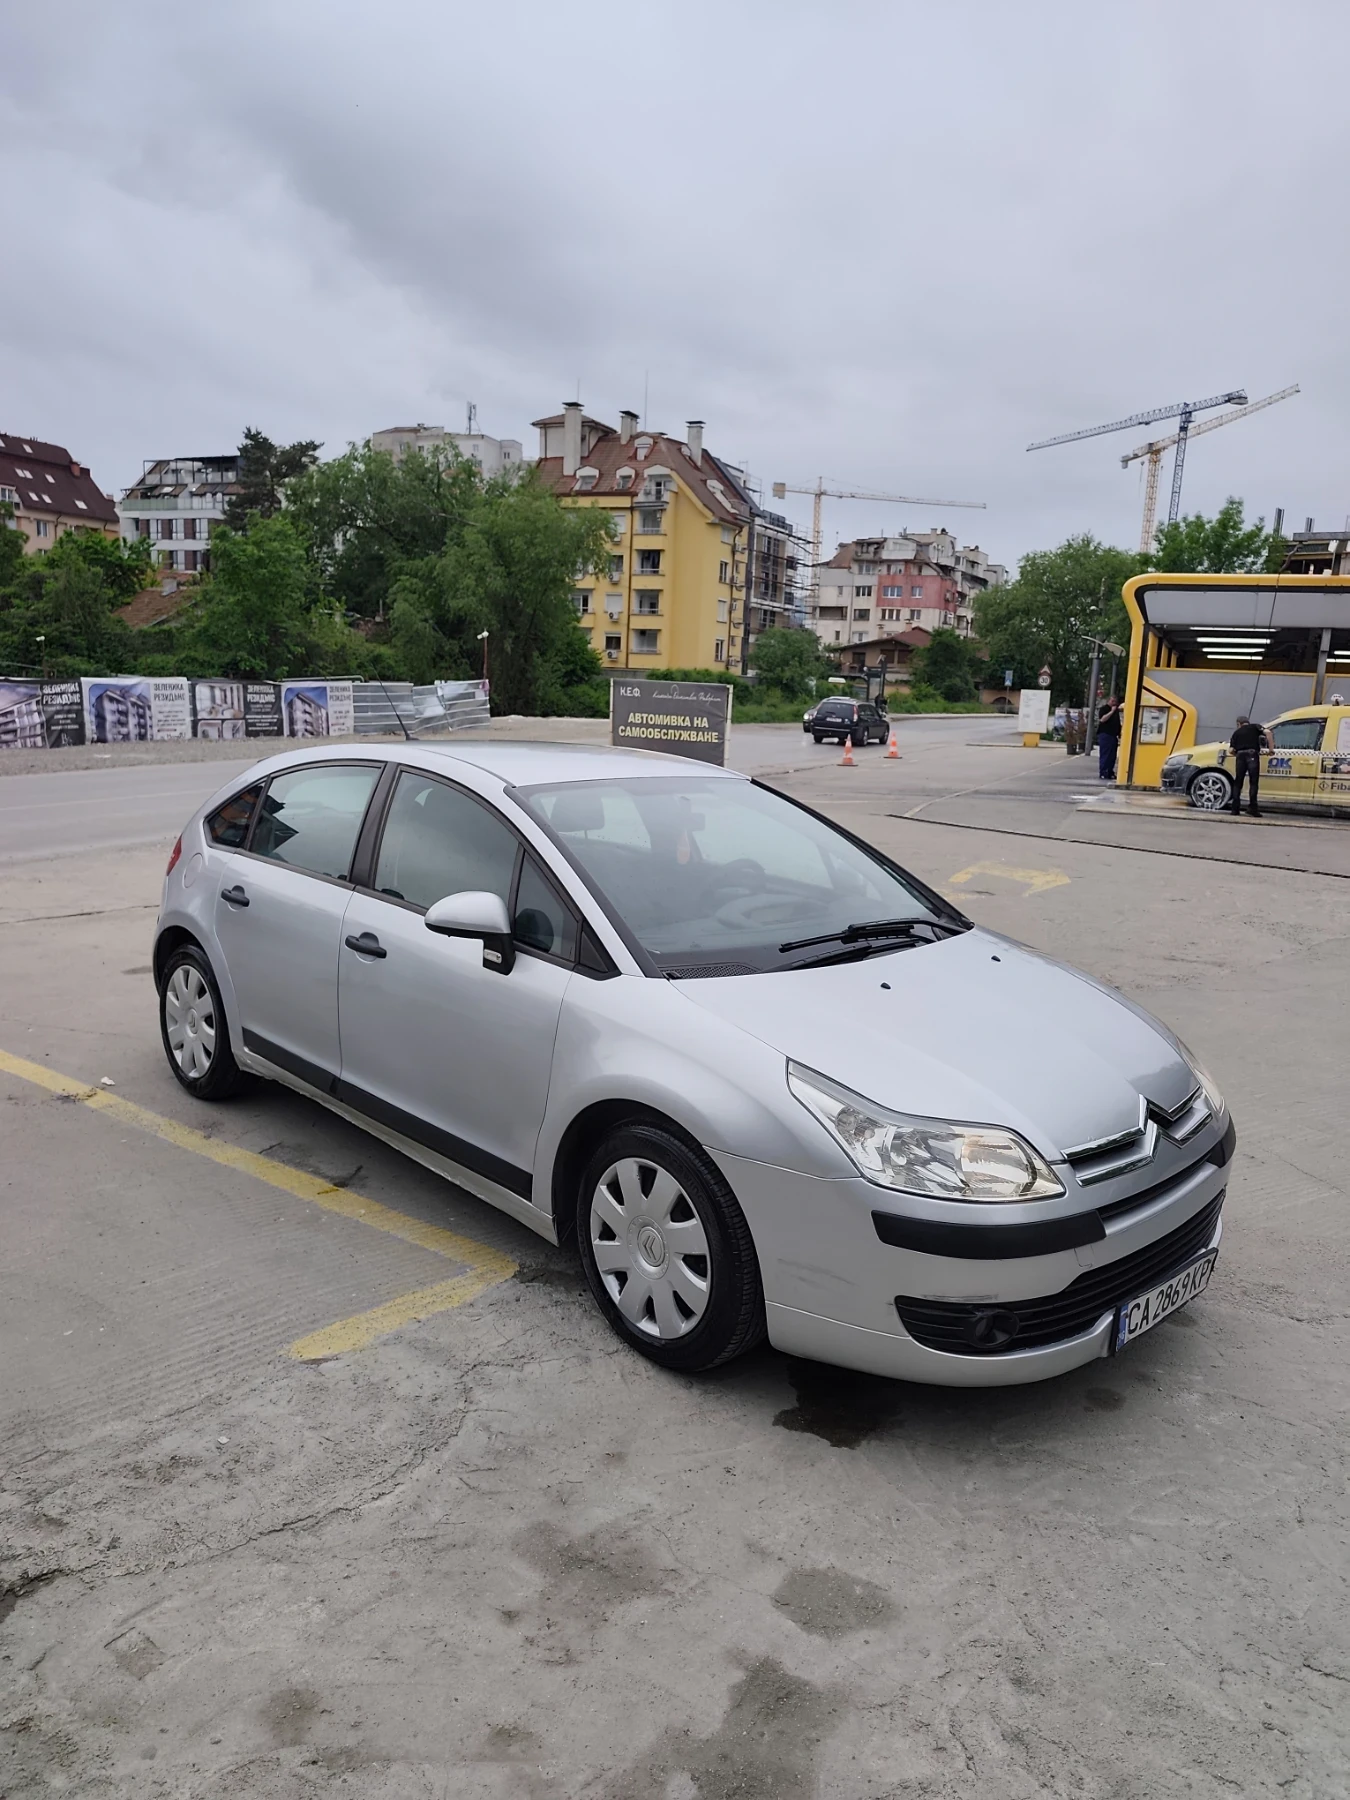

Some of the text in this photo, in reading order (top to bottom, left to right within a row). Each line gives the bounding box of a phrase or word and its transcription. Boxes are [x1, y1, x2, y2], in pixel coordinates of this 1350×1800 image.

[628, 712, 709, 728] АВТОМИВКА НА
[618, 725, 719, 743] САМООБСЛУЖВАНЕ
